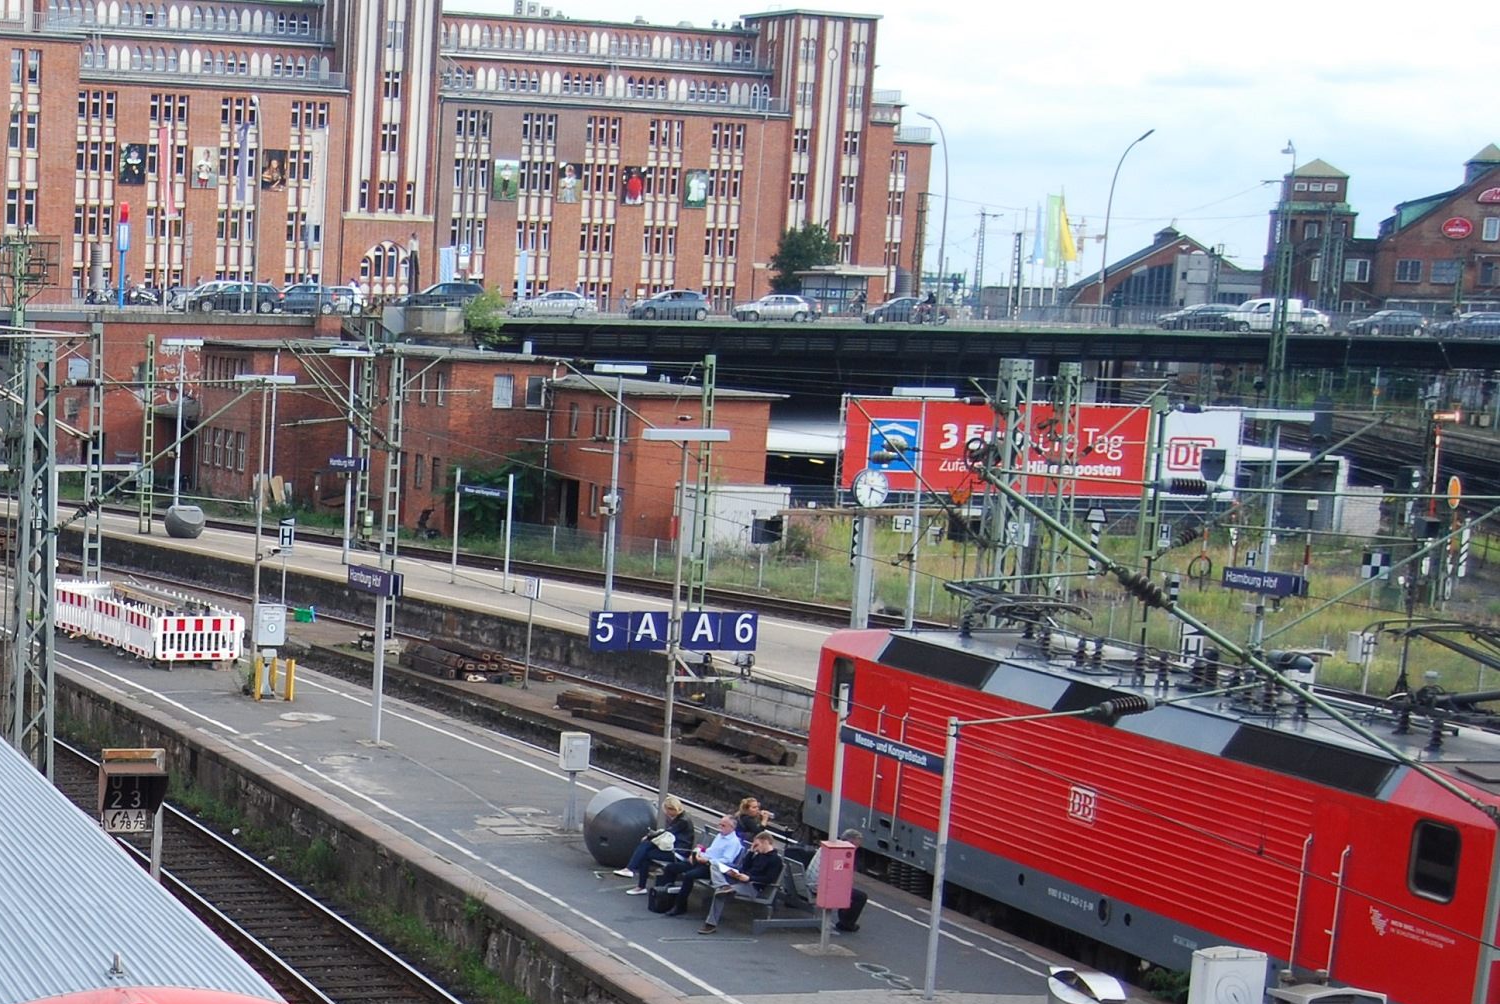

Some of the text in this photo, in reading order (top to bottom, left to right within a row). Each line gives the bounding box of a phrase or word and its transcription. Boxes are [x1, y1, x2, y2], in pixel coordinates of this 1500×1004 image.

[940, 423, 959, 450] 3
[1083, 428, 1124, 461] Tag
[282, 528, 292, 546] H
[1245, 551, 1256, 566] H
[350, 568, 382, 588] Hamburg Hbf
[1225, 571, 1278, 589] Hamburg Hbf
[595, 613, 658, 643] 5 A
[691, 613, 753, 644] A 6
